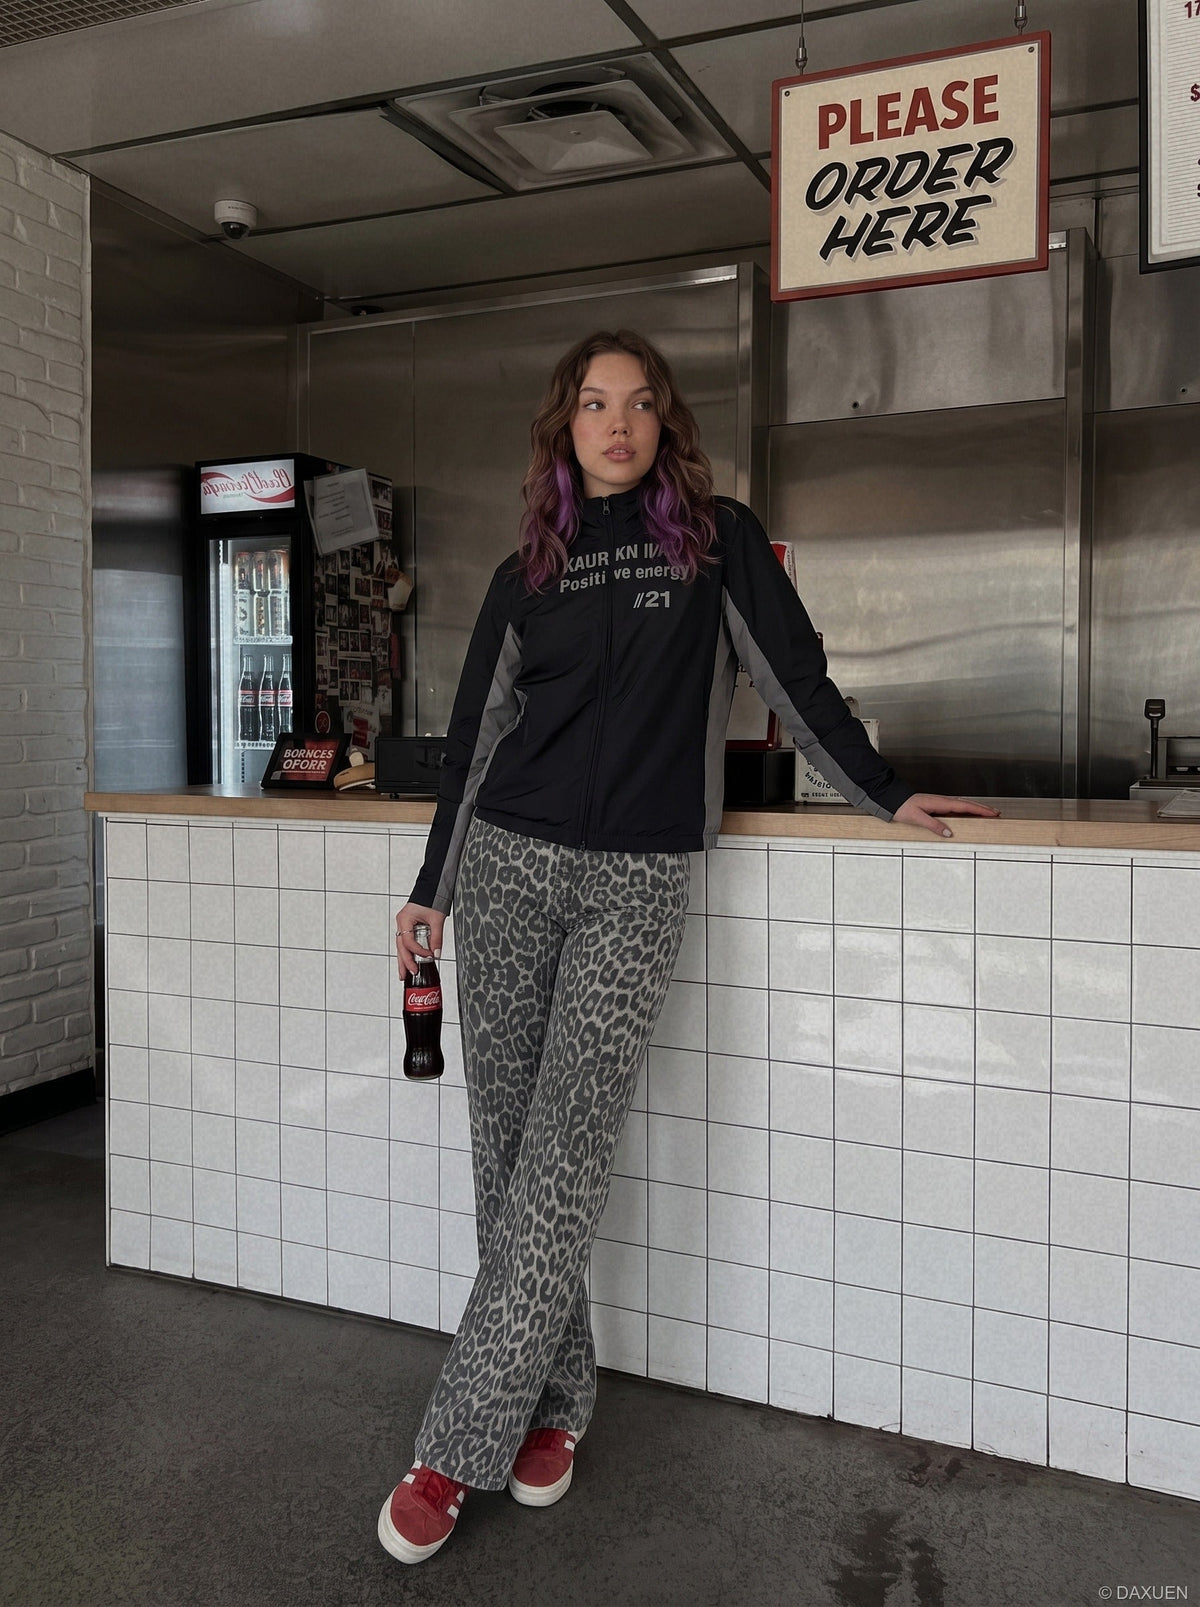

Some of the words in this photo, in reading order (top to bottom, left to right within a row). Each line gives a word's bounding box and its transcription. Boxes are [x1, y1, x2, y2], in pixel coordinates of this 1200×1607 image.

[818, 74, 999, 150] PLEASE
[805, 137, 1015, 212] ORDER
[819, 194, 994, 263] HERE
[635, 564, 689, 581] energy
